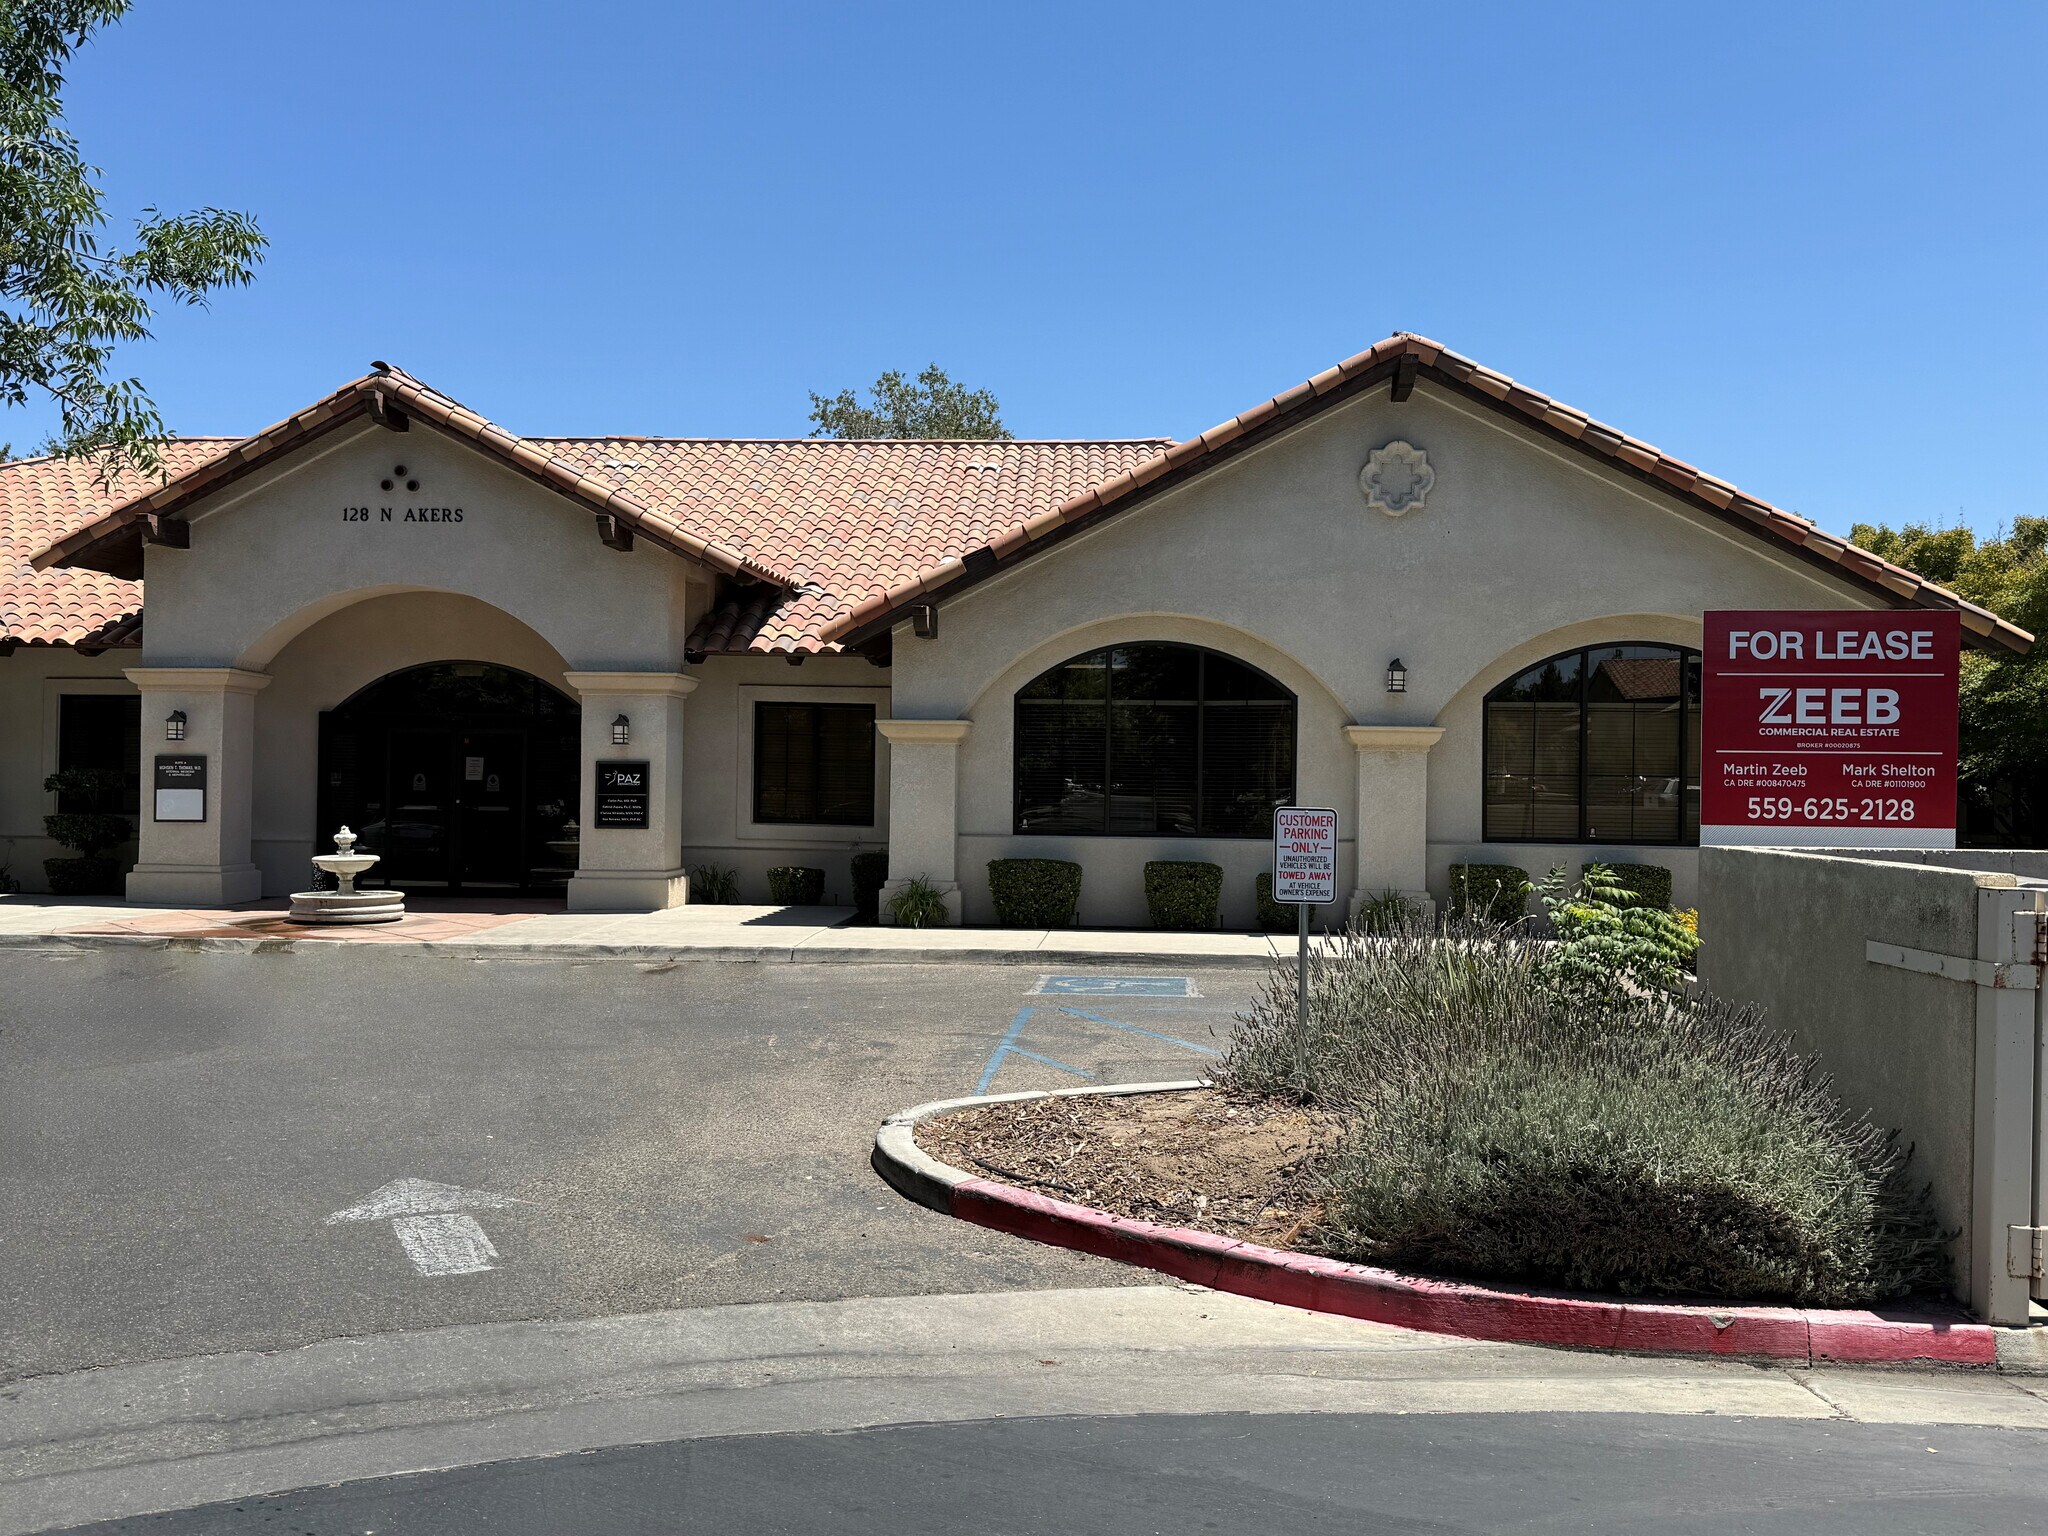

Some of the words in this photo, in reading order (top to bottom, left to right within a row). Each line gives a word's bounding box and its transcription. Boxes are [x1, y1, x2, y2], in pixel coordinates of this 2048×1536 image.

[342, 507, 369, 522] 128
[380, 507, 392, 522] N
[404, 508, 464, 523] AKERS
[1729, 630, 1804, 660] FOR
[1815, 630, 1934, 660] LEASE
[1758, 688, 1901, 725] ZEEB
[1758, 728, 1829, 737] COMMERCIAL
[1830, 728, 1858, 737] REAL
[1860, 728, 1900, 737] ESTATE
[1723, 763, 1768, 776] Martin
[1772, 763, 1808, 776] Zeeb
[1842, 764, 1877, 776] Mark
[1881, 764, 1936, 777] Shelton
[617, 773, 641, 784] PAZ
[1723, 779, 1736, 787] CA
[1737, 779, 1754, 787] DRE
[1756, 779, 1806, 788] #008470475
[1851, 780, 1863, 788] CA
[1865, 780, 1882, 788] DRE
[1884, 780, 1926, 788] #01101900
[1747, 797, 1915, 821] 559-625-2128
[1279, 814, 1334, 828] CUSTOMER
[1284, 827, 1328, 840] PARKING
[1291, 841, 1320, 854] ONLY
[1283, 855, 1328, 863] UNAUTHORIZED
[1279, 861, 1307, 870] VEHICLES
[1323, 862, 1332, 870] BE
[1278, 870, 1306, 880] TOWED
[1308, 871, 1332, 881] AWAY
[1288, 881, 1297, 889] AT
[1297, 882, 1321, 890] VEHICLE
[1279, 888, 1305, 897] OWNER'S
[1305, 889, 1331, 897] EXPENSE
